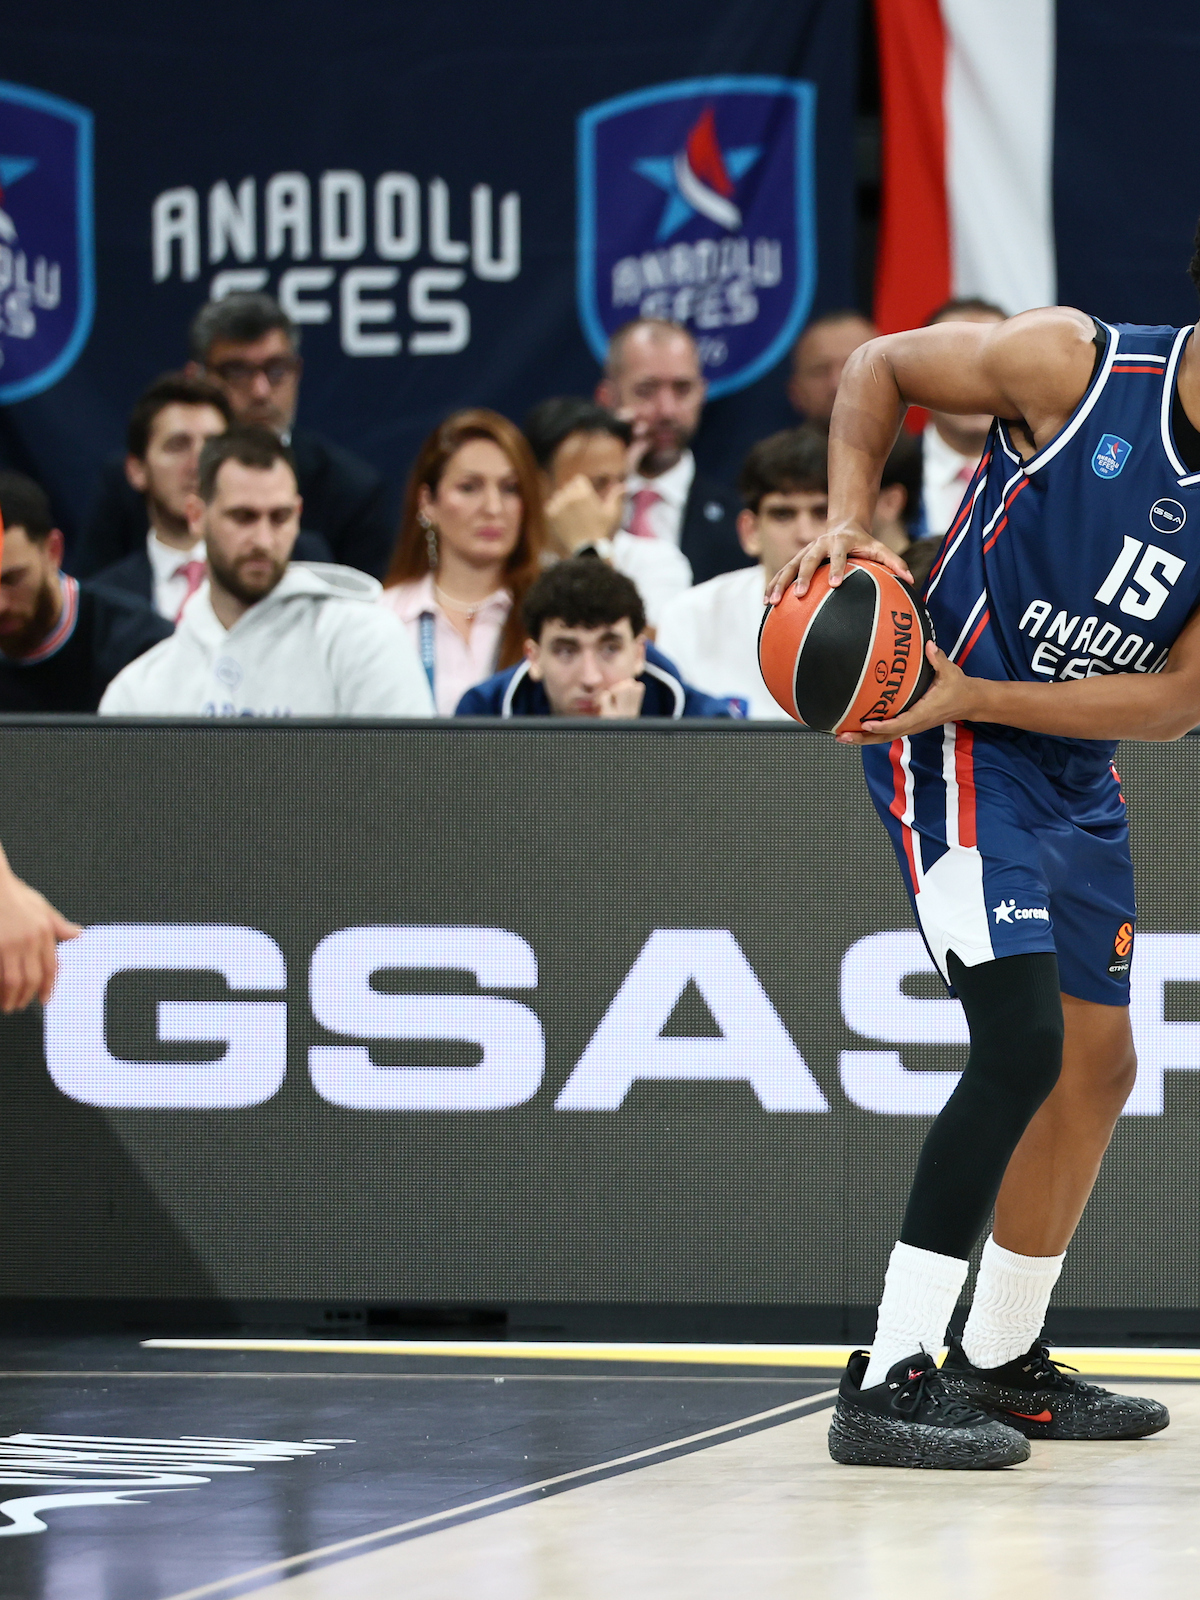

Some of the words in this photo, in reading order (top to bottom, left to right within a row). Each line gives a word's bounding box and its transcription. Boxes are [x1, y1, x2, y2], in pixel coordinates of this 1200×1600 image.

[152, 169, 521, 283] ANADOLU
[210, 267, 471, 357] FES
[1153, 506, 1182, 525] GSA
[1094, 534, 1187, 621] 15
